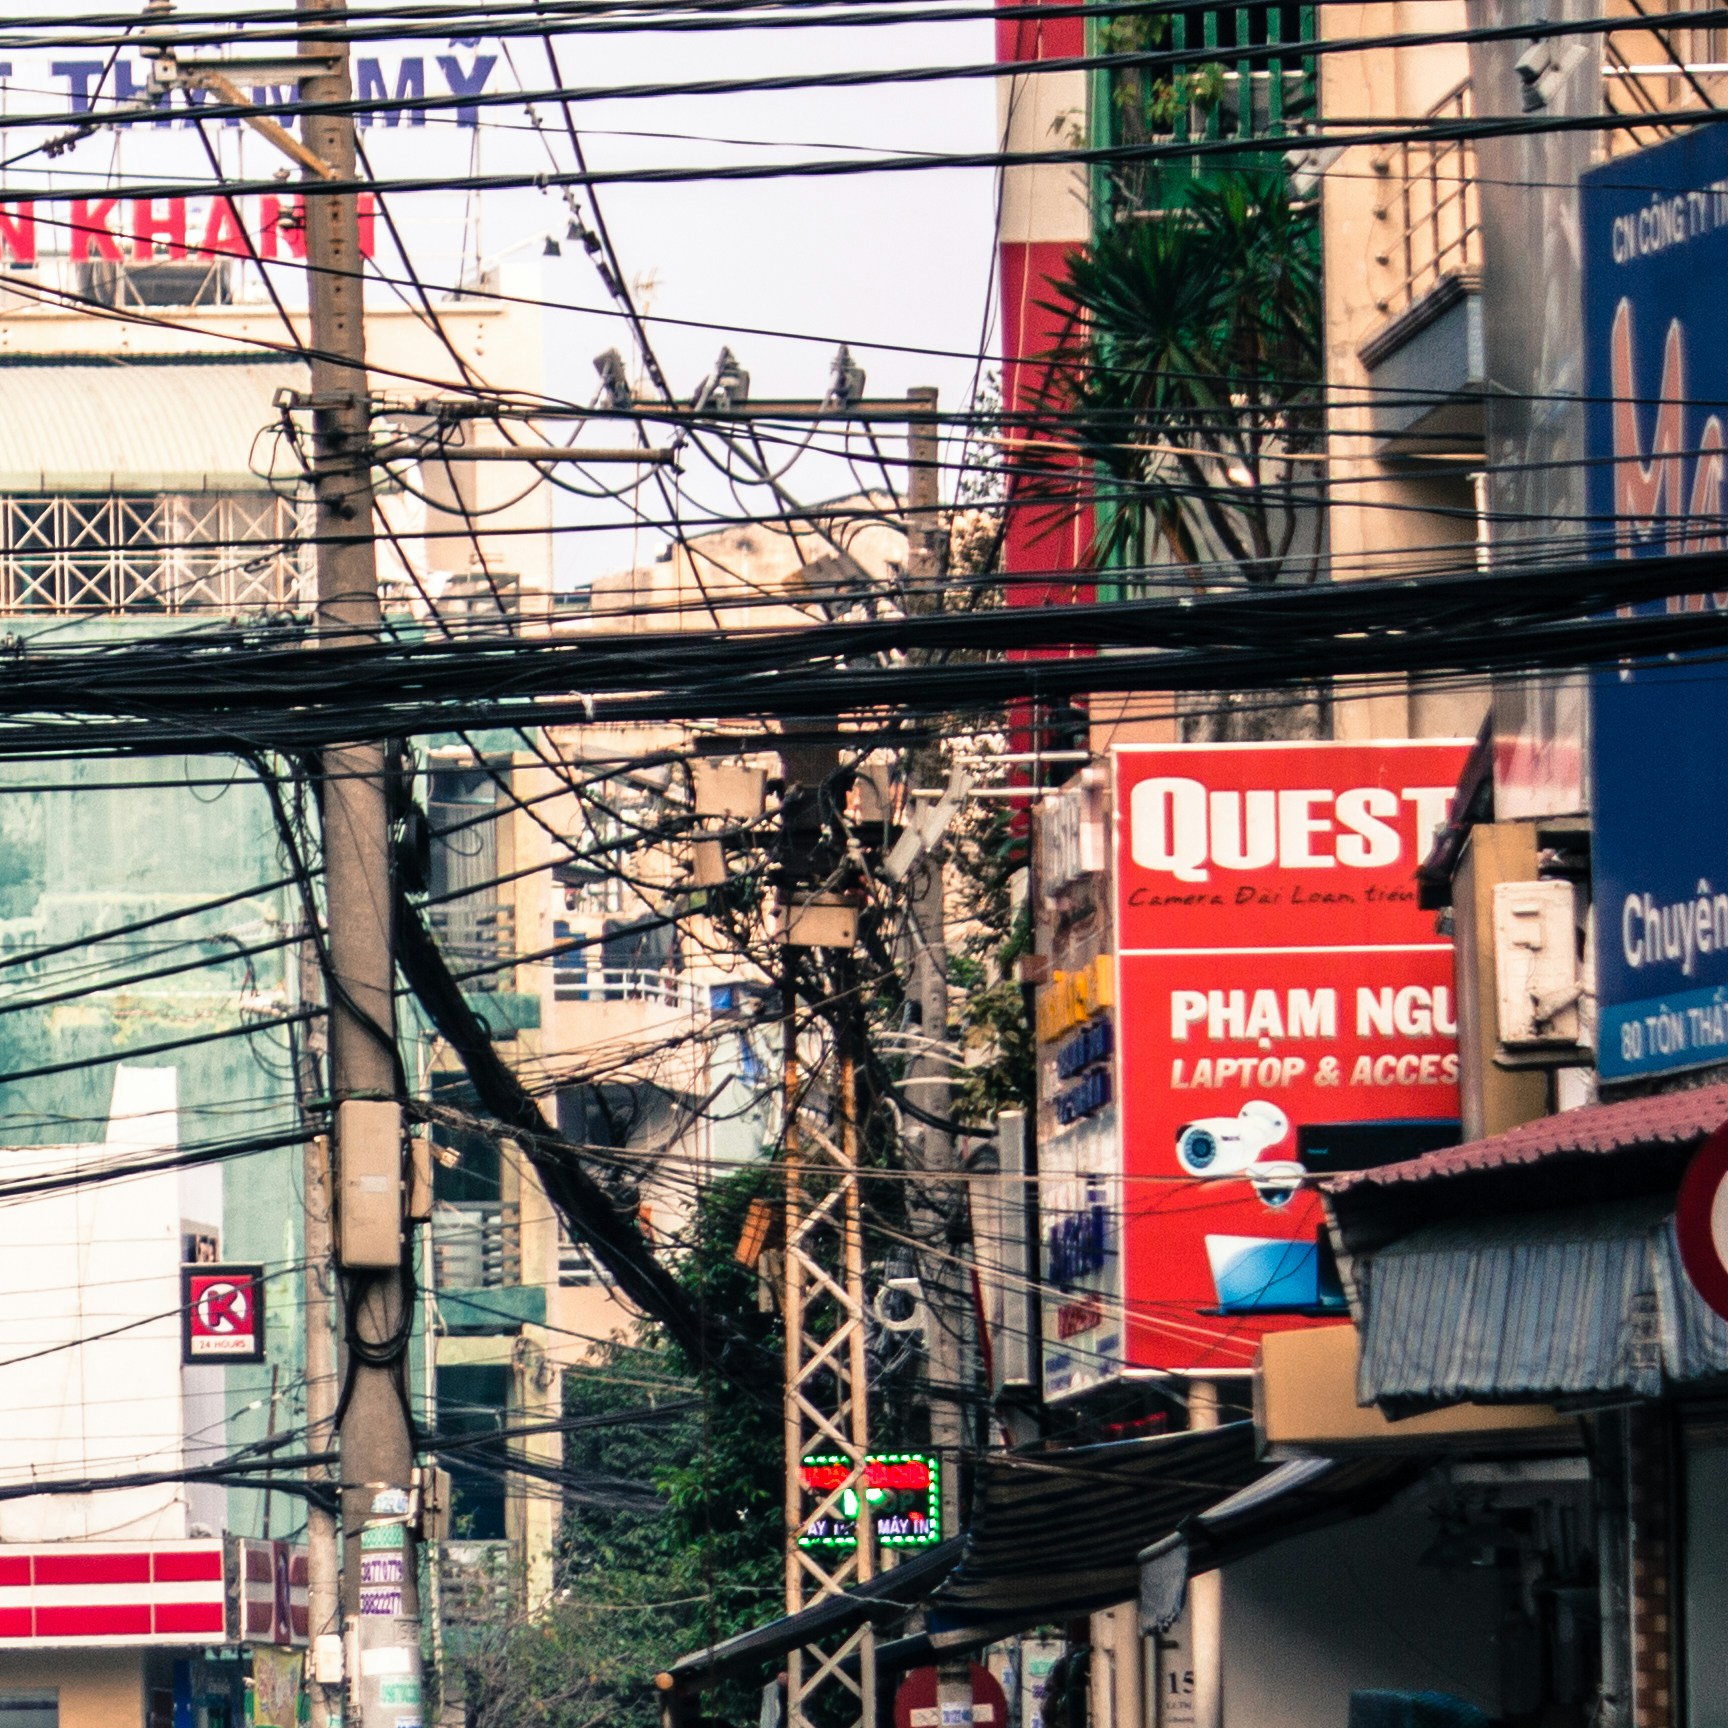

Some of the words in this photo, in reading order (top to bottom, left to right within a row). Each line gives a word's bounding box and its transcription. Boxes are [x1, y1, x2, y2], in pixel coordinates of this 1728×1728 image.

[1127, 887, 1224, 907] Camera
[1170, 987, 1337, 1050] PHẠM
[1170, 1057, 1306, 1091] LAPTOP
[1313, 1058, 1340, 1087] &
